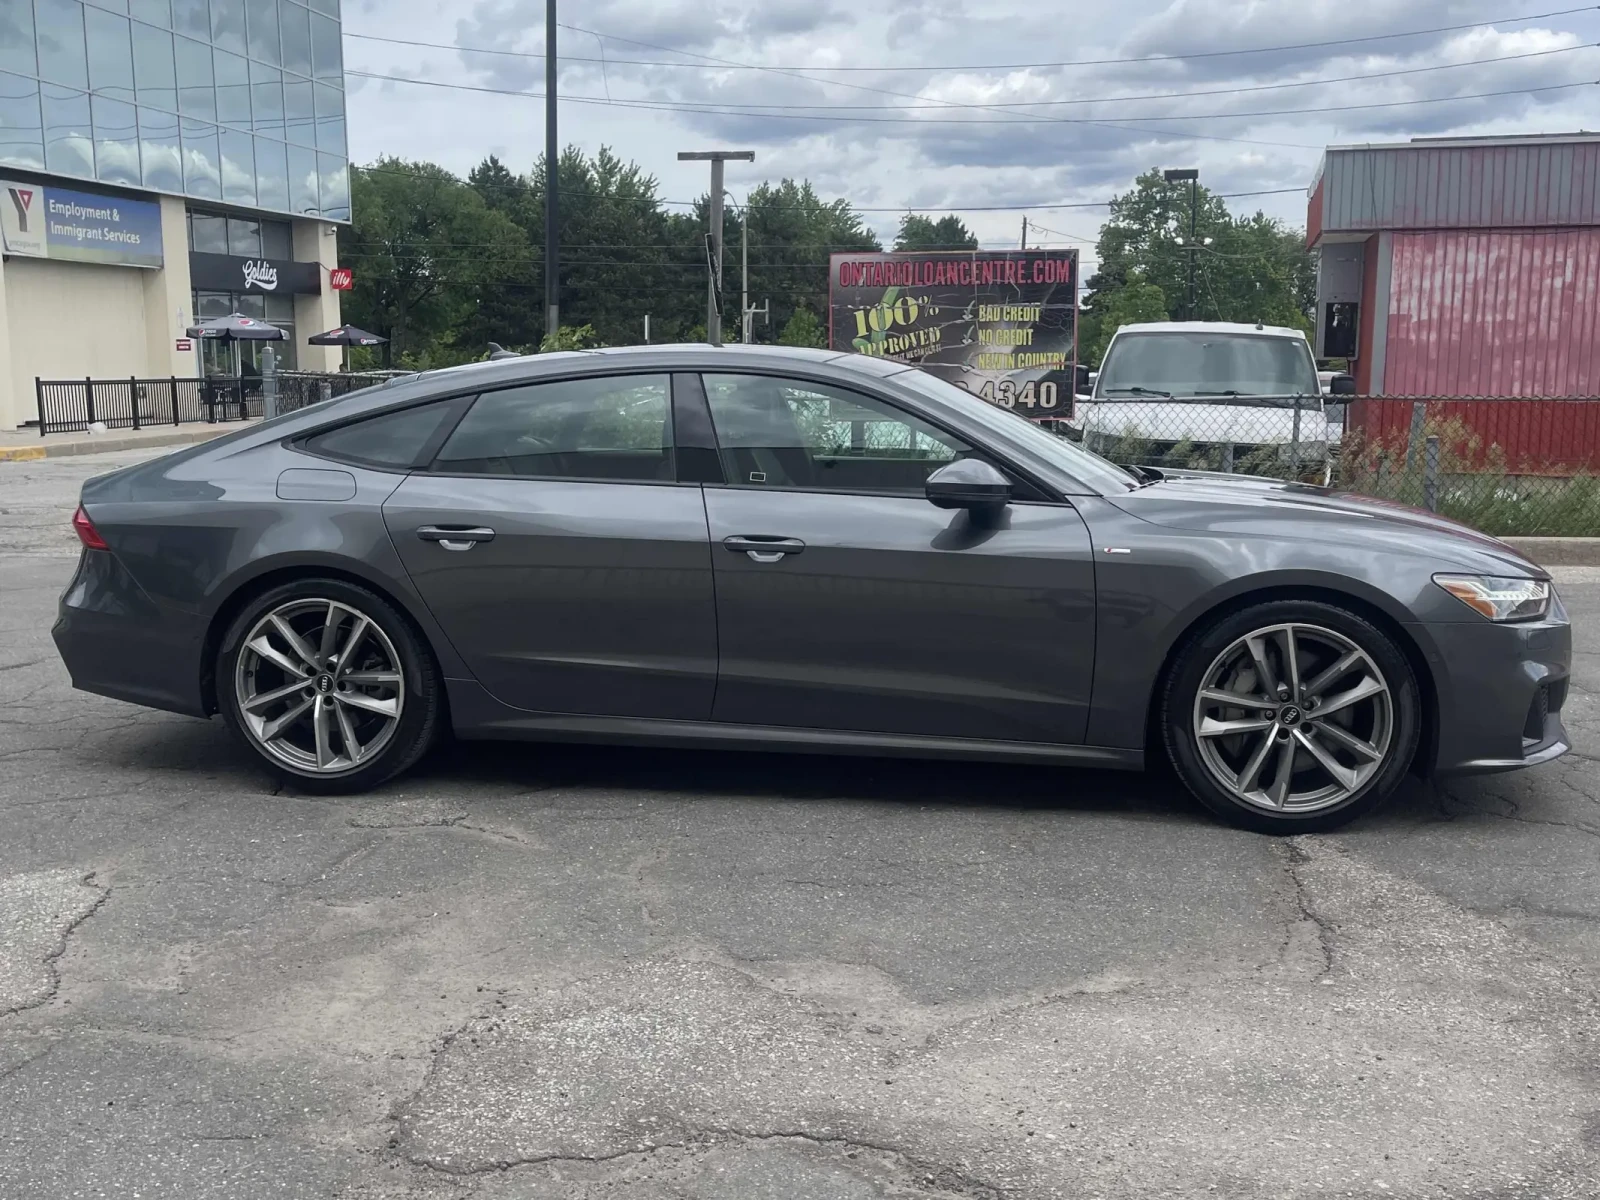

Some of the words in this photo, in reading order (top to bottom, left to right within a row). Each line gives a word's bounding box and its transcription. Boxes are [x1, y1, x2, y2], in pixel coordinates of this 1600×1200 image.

[49, 199, 111, 220] Employment
[112, 208, 120, 222] &
[50, 221, 102, 241] Immigrant
[103, 228, 141, 244] Services
[242, 260, 278, 291] Goldies
[332, 271, 350, 288] illy
[840, 260, 1070, 286] ONTARIOLOANCENTRE.COM
[853, 295, 940, 337] 100%
[978, 304, 1001, 321] BAD
[1003, 303, 1041, 321] CREDIT
[859, 326, 941, 356] APPROVED
[978, 329, 993, 346] NO
[995, 328, 1034, 346] CREDIT
[978, 352, 1002, 370] NEW
[1003, 352, 1015, 369] IN
[1017, 352, 1067, 371] COUNTRY
